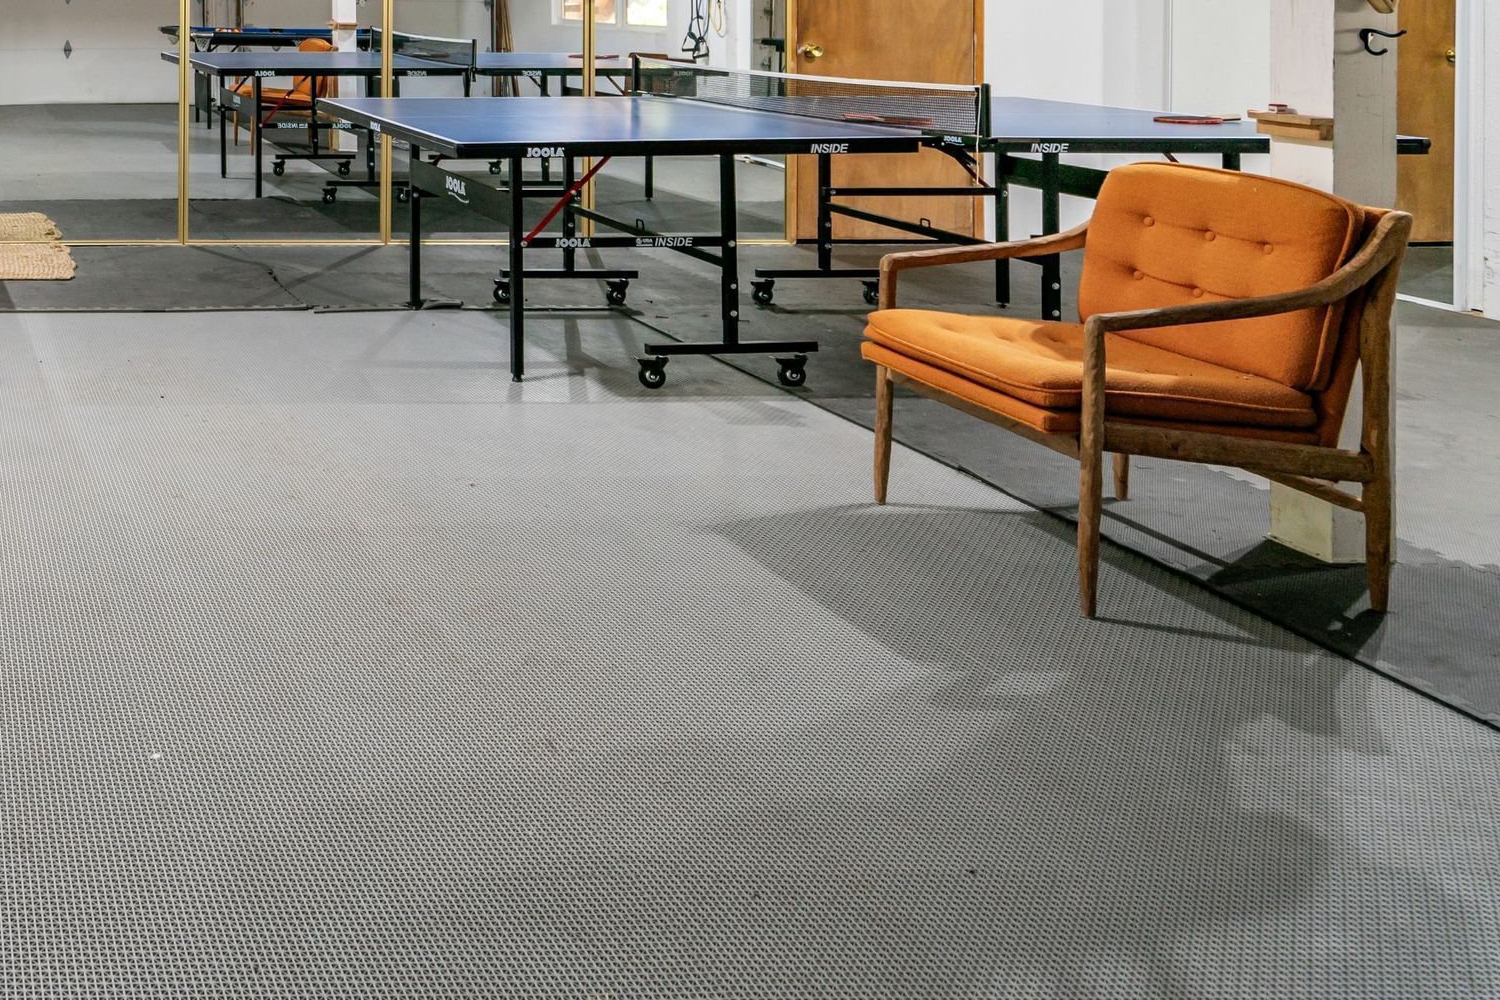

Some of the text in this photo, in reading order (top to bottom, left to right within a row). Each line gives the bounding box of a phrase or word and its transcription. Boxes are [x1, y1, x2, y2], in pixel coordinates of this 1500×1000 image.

[526, 147, 565, 158] JOOLA
[810, 143, 849, 154] INSIDE
[1030, 143, 1069, 154] INSIDE
[445, 175, 466, 196] JOOLA
[555, 238, 591, 248] JOOLA
[654, 237, 693, 247] INSIDE
